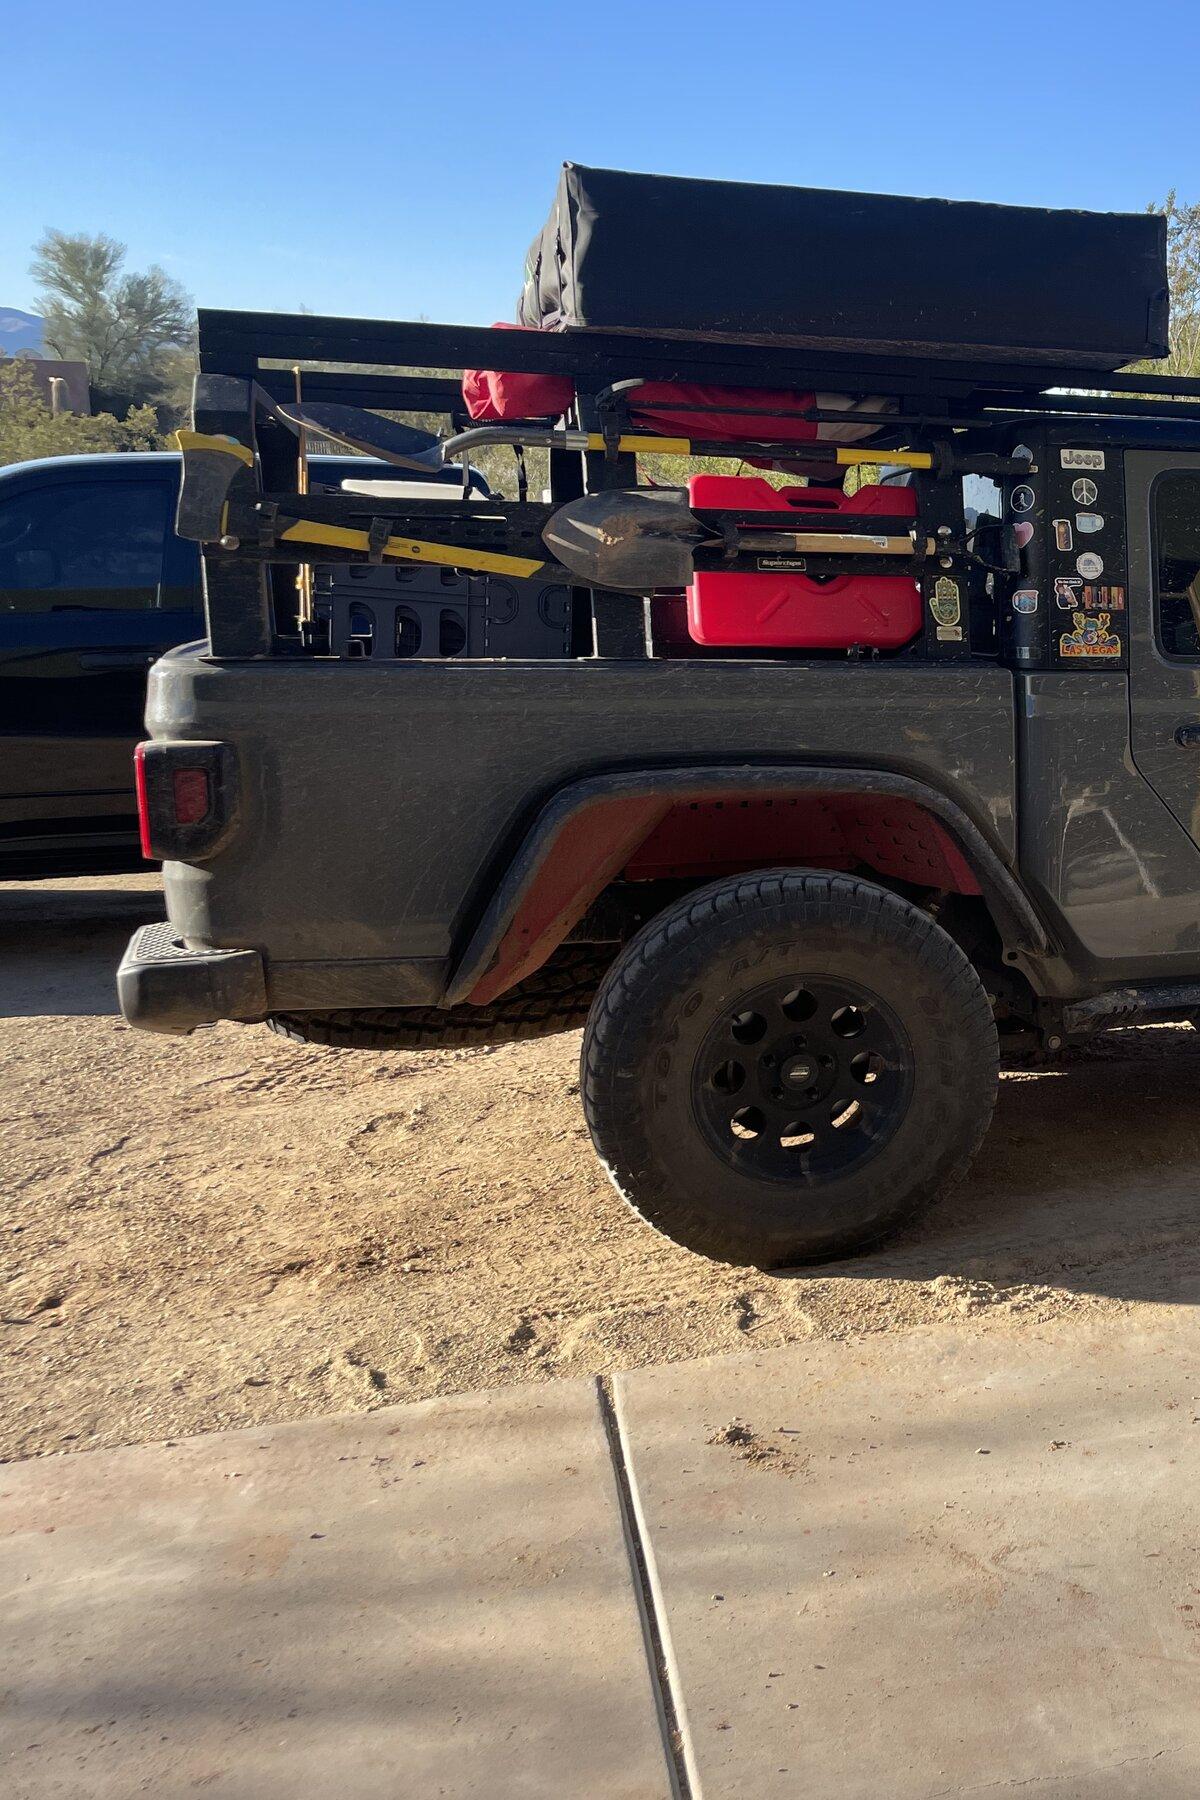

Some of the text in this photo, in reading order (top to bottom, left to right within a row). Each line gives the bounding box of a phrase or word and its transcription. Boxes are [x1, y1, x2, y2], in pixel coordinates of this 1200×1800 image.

[1063, 451, 1102, 468] Jeep
[761, 559, 802, 567] Superchips
[1061, 644, 1119, 655] LAS VEGAS
